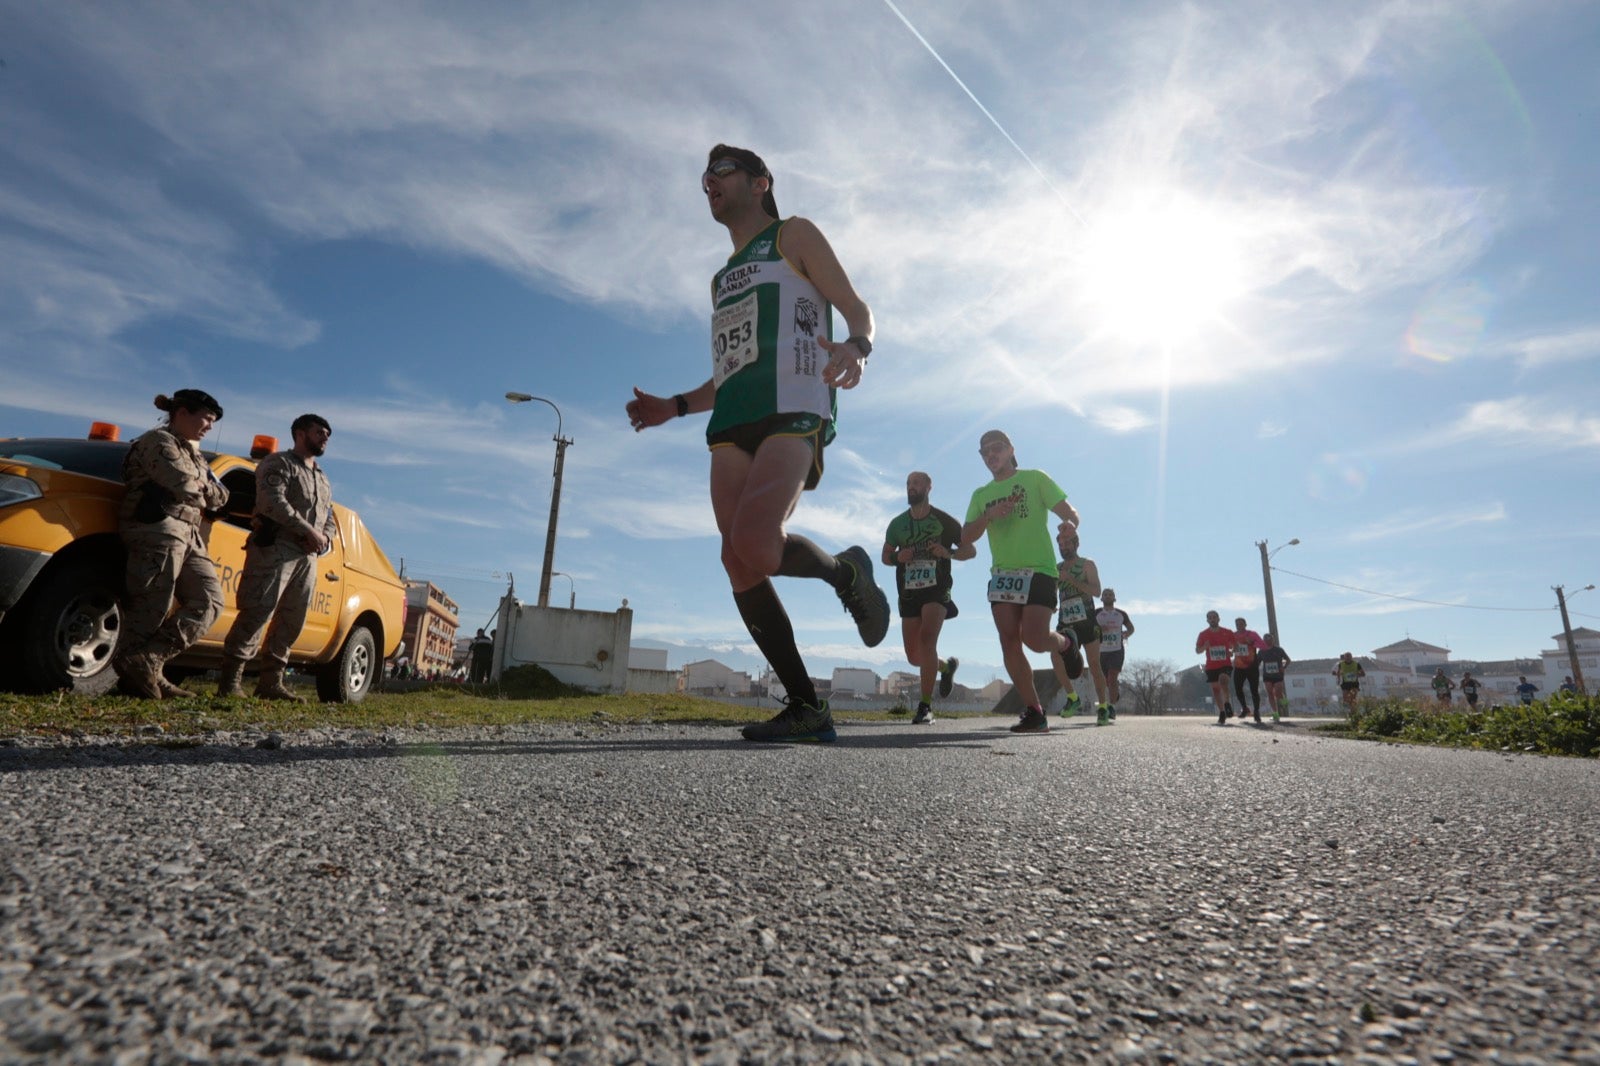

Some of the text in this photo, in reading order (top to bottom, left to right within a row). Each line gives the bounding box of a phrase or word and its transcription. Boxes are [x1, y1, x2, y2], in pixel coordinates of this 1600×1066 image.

[726, 264, 761, 284] RURAL
[713, 320, 752, 363] 3053
[910, 569, 930, 580] 278
[996, 576, 1024, 592] 530
